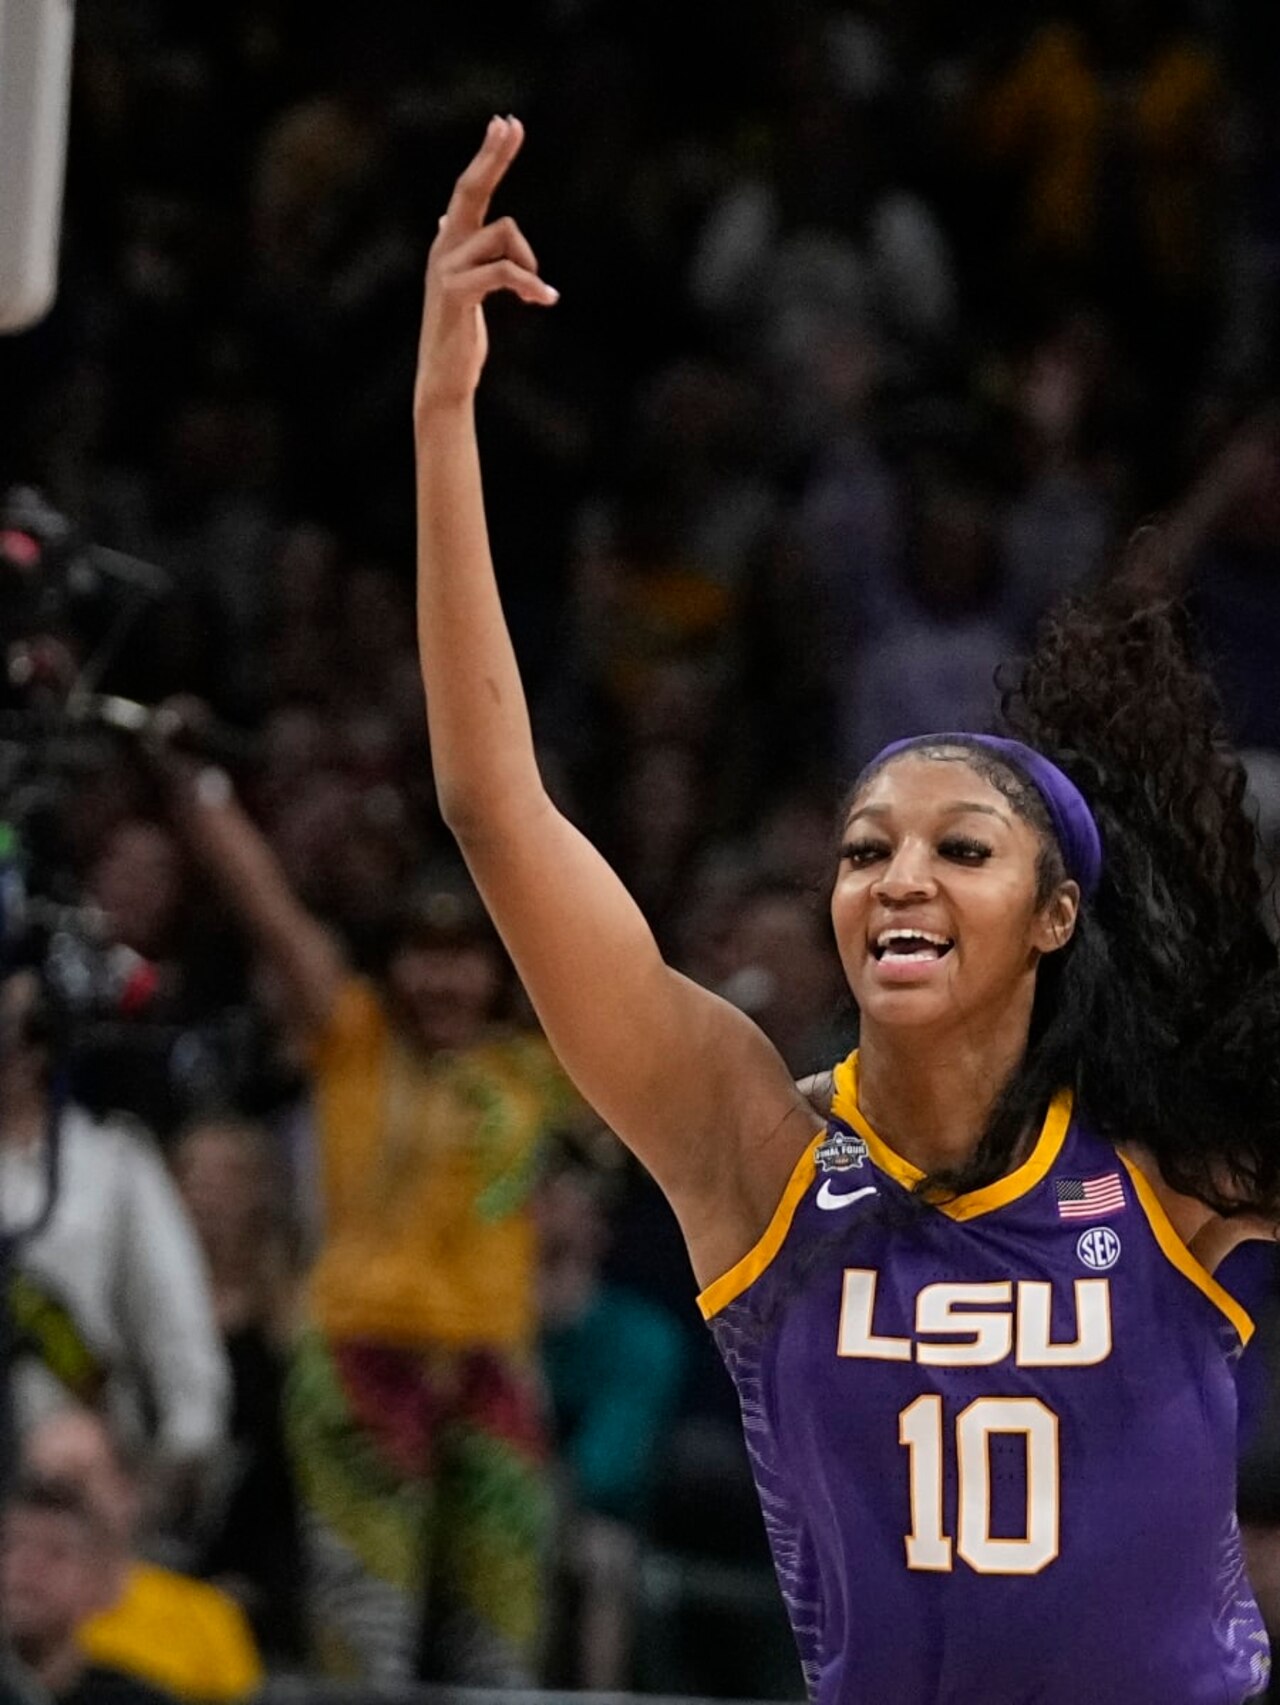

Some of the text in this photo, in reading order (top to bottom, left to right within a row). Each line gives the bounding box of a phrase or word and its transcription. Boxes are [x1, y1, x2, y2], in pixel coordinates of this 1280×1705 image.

[1081, 1230, 1116, 1265] SEC
[837, 1268, 1112, 1366] LSU
[898, 1394, 1059, 1575] 10
